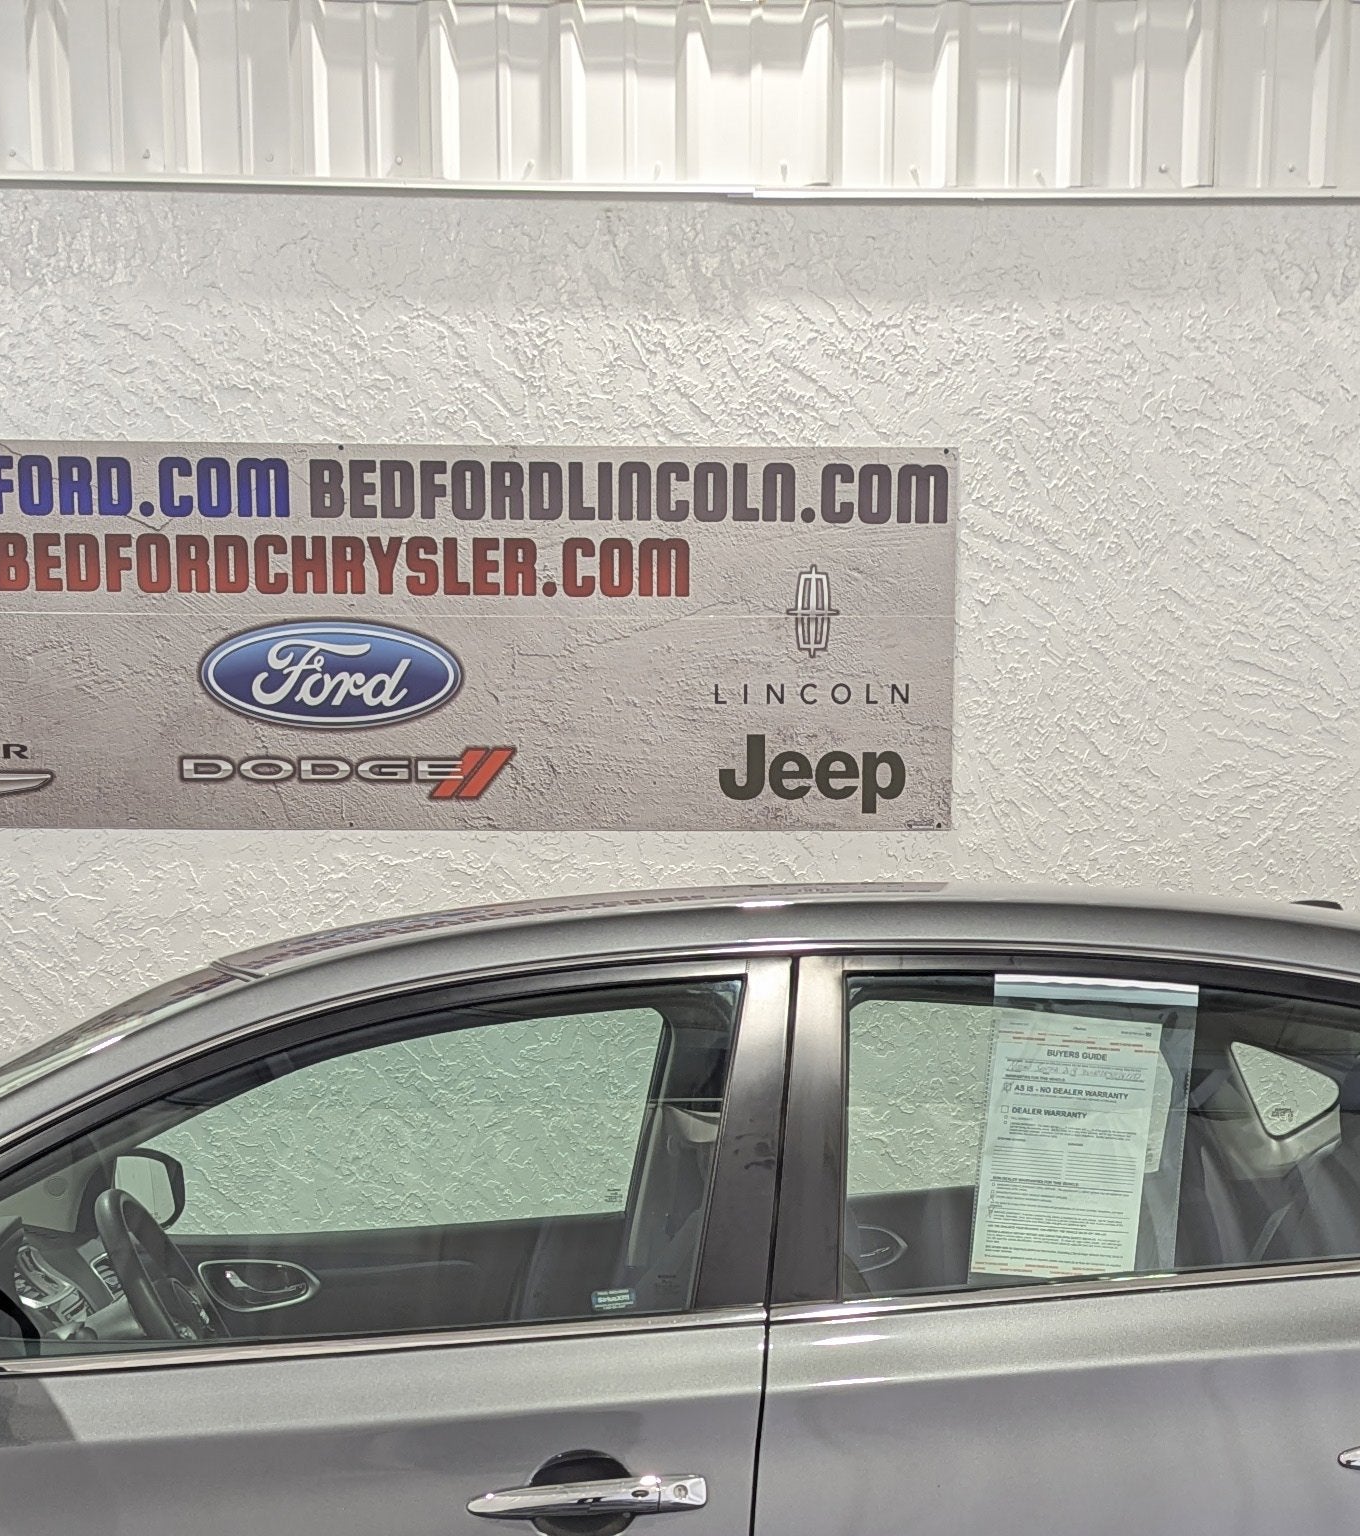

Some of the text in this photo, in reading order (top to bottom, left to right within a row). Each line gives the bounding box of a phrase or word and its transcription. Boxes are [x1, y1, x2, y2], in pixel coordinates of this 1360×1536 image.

[309, 458, 948, 525] BEDFORDLINCOLN.COM
[252, 640, 413, 709] Ford
[713, 682, 911, 706] LINCOLN
[181, 757, 463, 783] DODGE
[718, 733, 907, 814] Jeep
[1046, 1049, 1108, 1061] BUYERS GUIDE
[1014, 1084, 1026, 1092] AS
[1052, 1087, 1084, 1097] DEALER
[1085, 1089, 1129, 1100] WARRANTY
[1011, 1106, 1043, 1116] DEALER
[1043, 1108, 1088, 1119] WARRANTY
